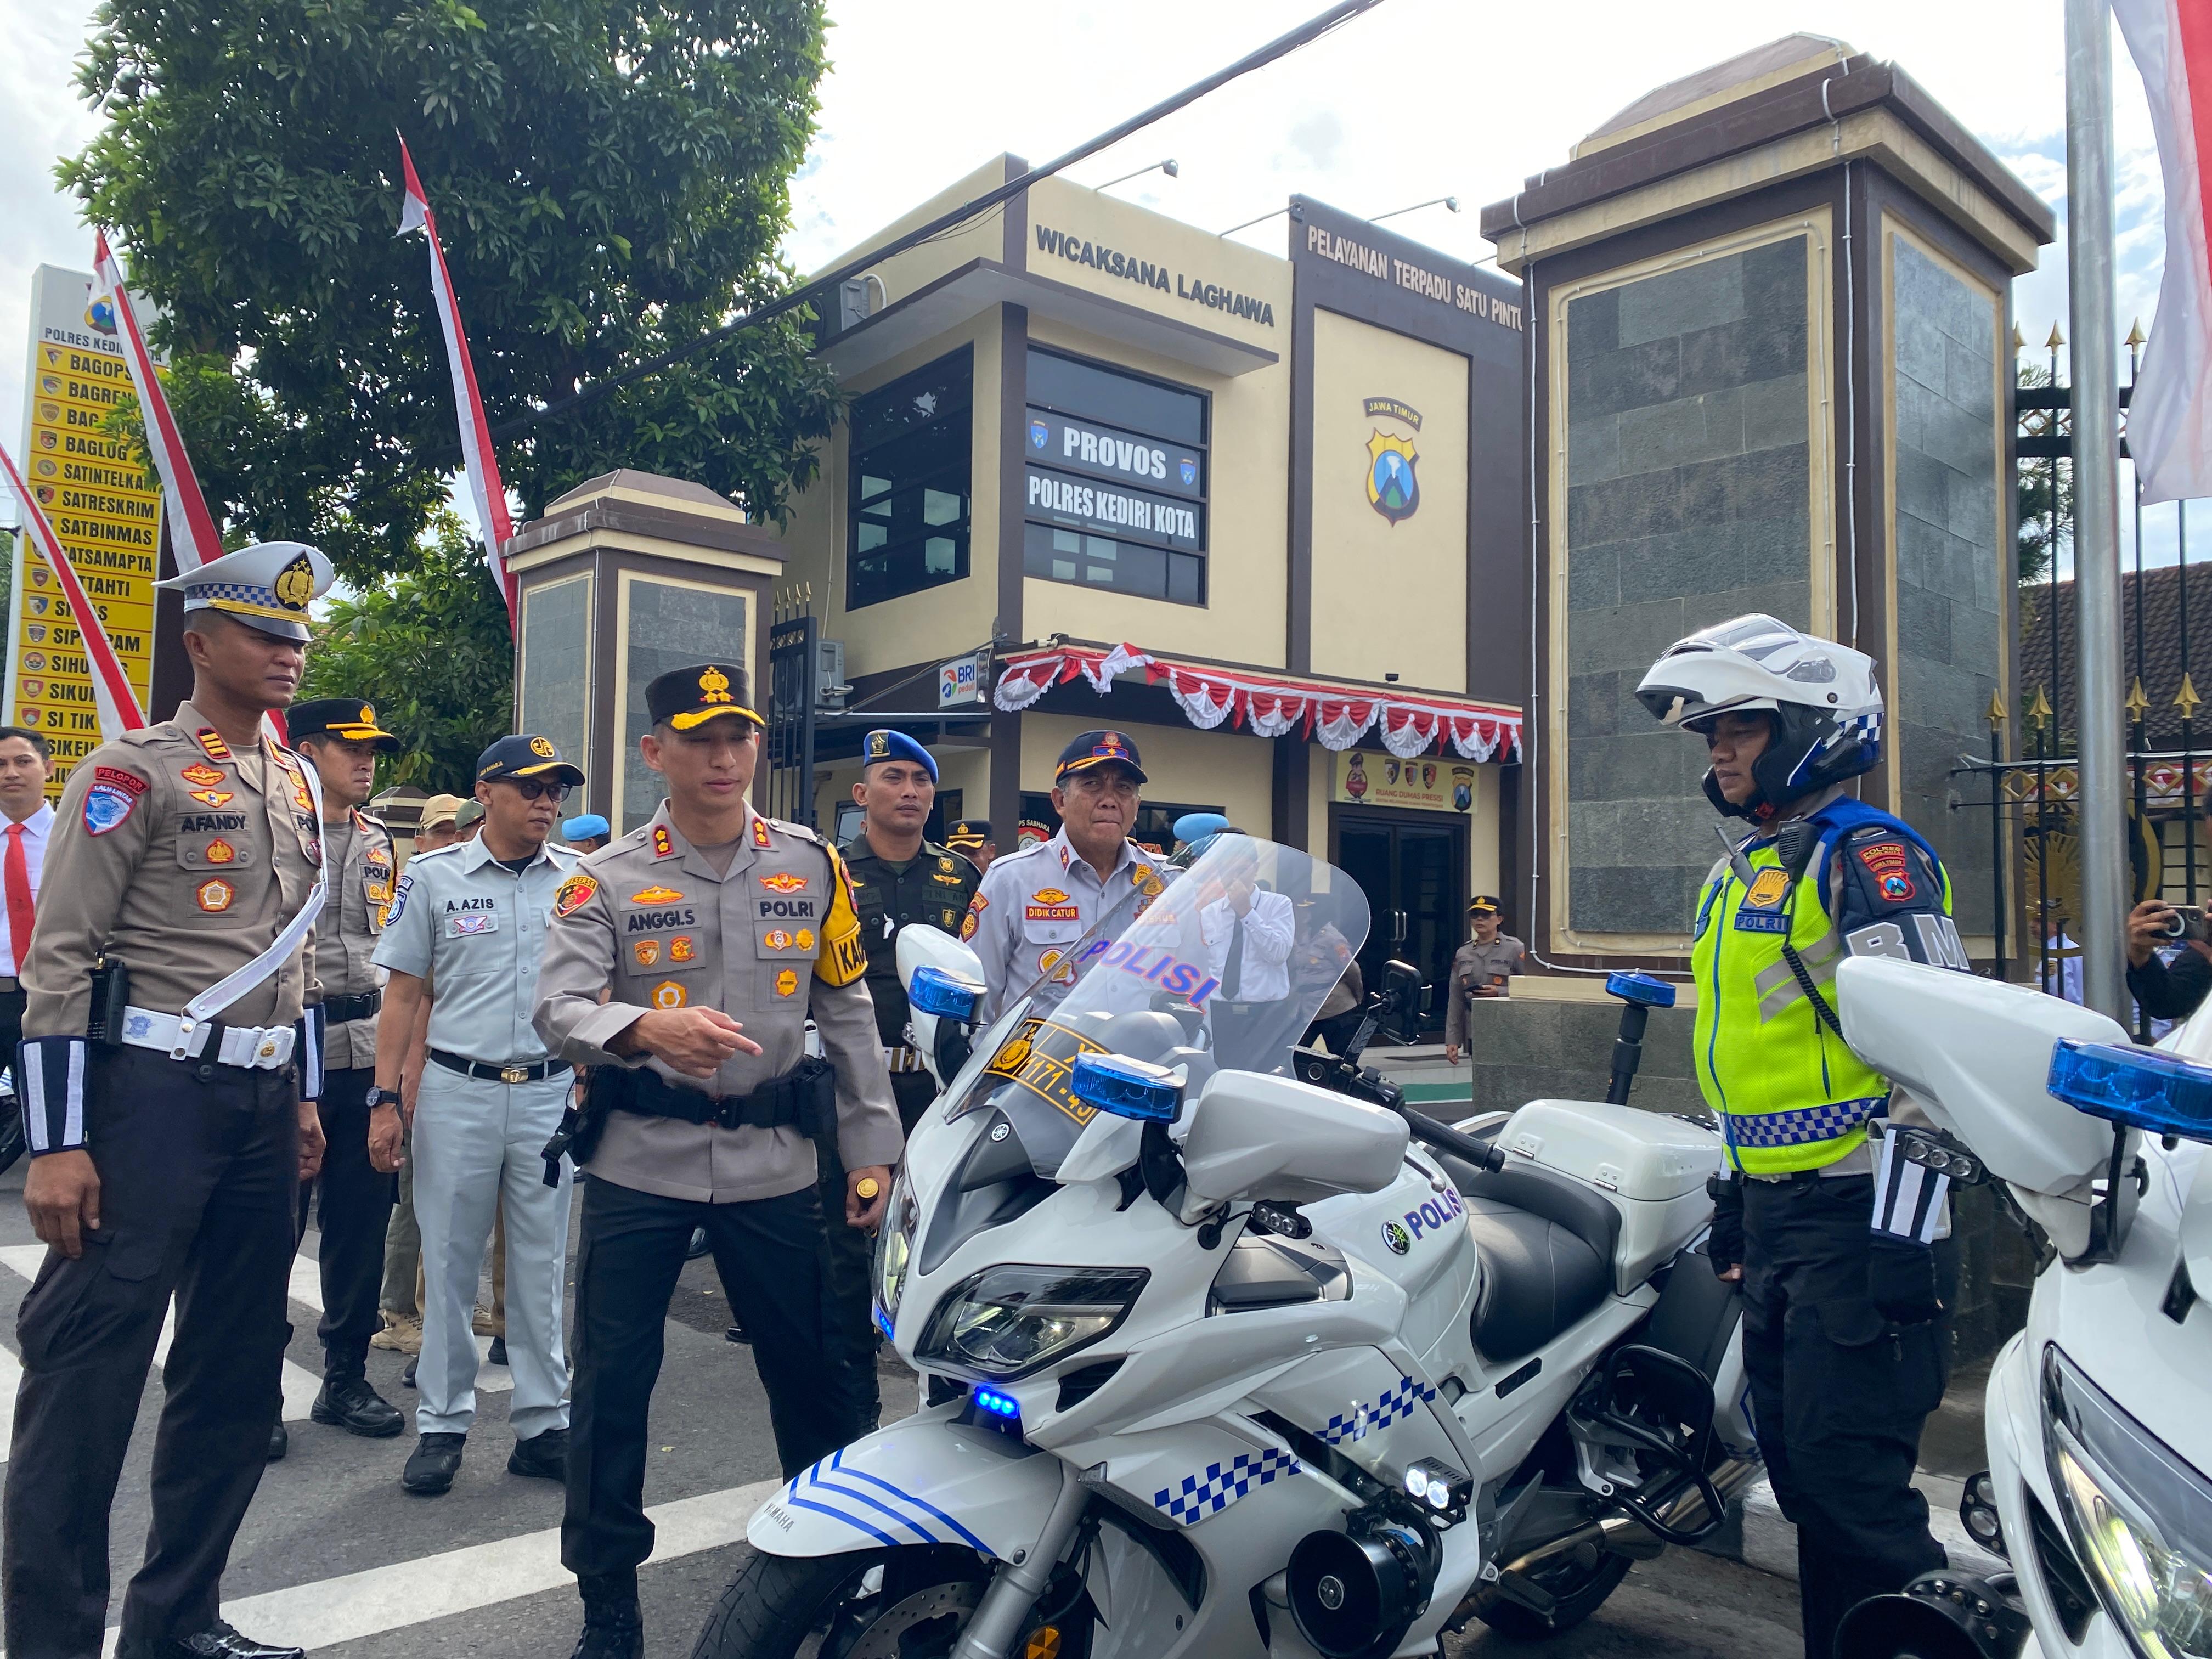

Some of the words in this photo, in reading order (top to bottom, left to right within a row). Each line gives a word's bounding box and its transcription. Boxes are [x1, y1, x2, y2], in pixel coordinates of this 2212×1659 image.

[1036, 224, 1170, 293] WICAKSANA
[1178, 274, 1274, 326] LAGHAWA
[1308, 225, 1387, 280] PELAYANAN
[1393, 259, 1451, 304] TERPADU
[1457, 284, 1487, 318] SATU
[44, 328, 89, 347] POLRES
[93, 337, 123, 354] KEDI
[70, 354, 132, 381] BAGOPS
[1369, 402, 1392, 413] JAWA
[1392, 404, 1419, 424] TIMUR
[1064, 427, 1166, 479] PROVOS
[64, 464, 156, 493] SATINTELKA
[62, 491, 154, 518] SATRESKRIM
[1029, 475, 1094, 517] POLRES
[1096, 491, 1151, 530] KEDIRI
[1154, 504, 1195, 539] KOTA
[60, 518, 153, 545] SATBINMAS
[958, 664, 975, 684] BRI
[958, 683, 975, 695] peduli
[47, 711, 64, 727] SI
[70, 713, 95, 730] TIK
[98, 769, 143, 791] PELOPOR
[113, 788, 133, 803] LINTAS
[1376, 789, 1398, 797] RUANG
[1398, 791, 1420, 799] DUMAS
[1421, 793, 1443, 802] PRESISI
[182, 814, 246, 832] AFANDY
[1026, 819, 1050, 832] SABHARA
[1863, 846, 1901, 857] POLRES
[760, 901, 814, 917] POLRI
[1029, 908, 1050, 917] DIDIK
[1051, 909, 1076, 917] CATUR
[1737, 916, 1783, 930] POLRI
[1077, 939, 1220, 1008] POLISI
[764, 1503, 794, 1532] YAMAHA
